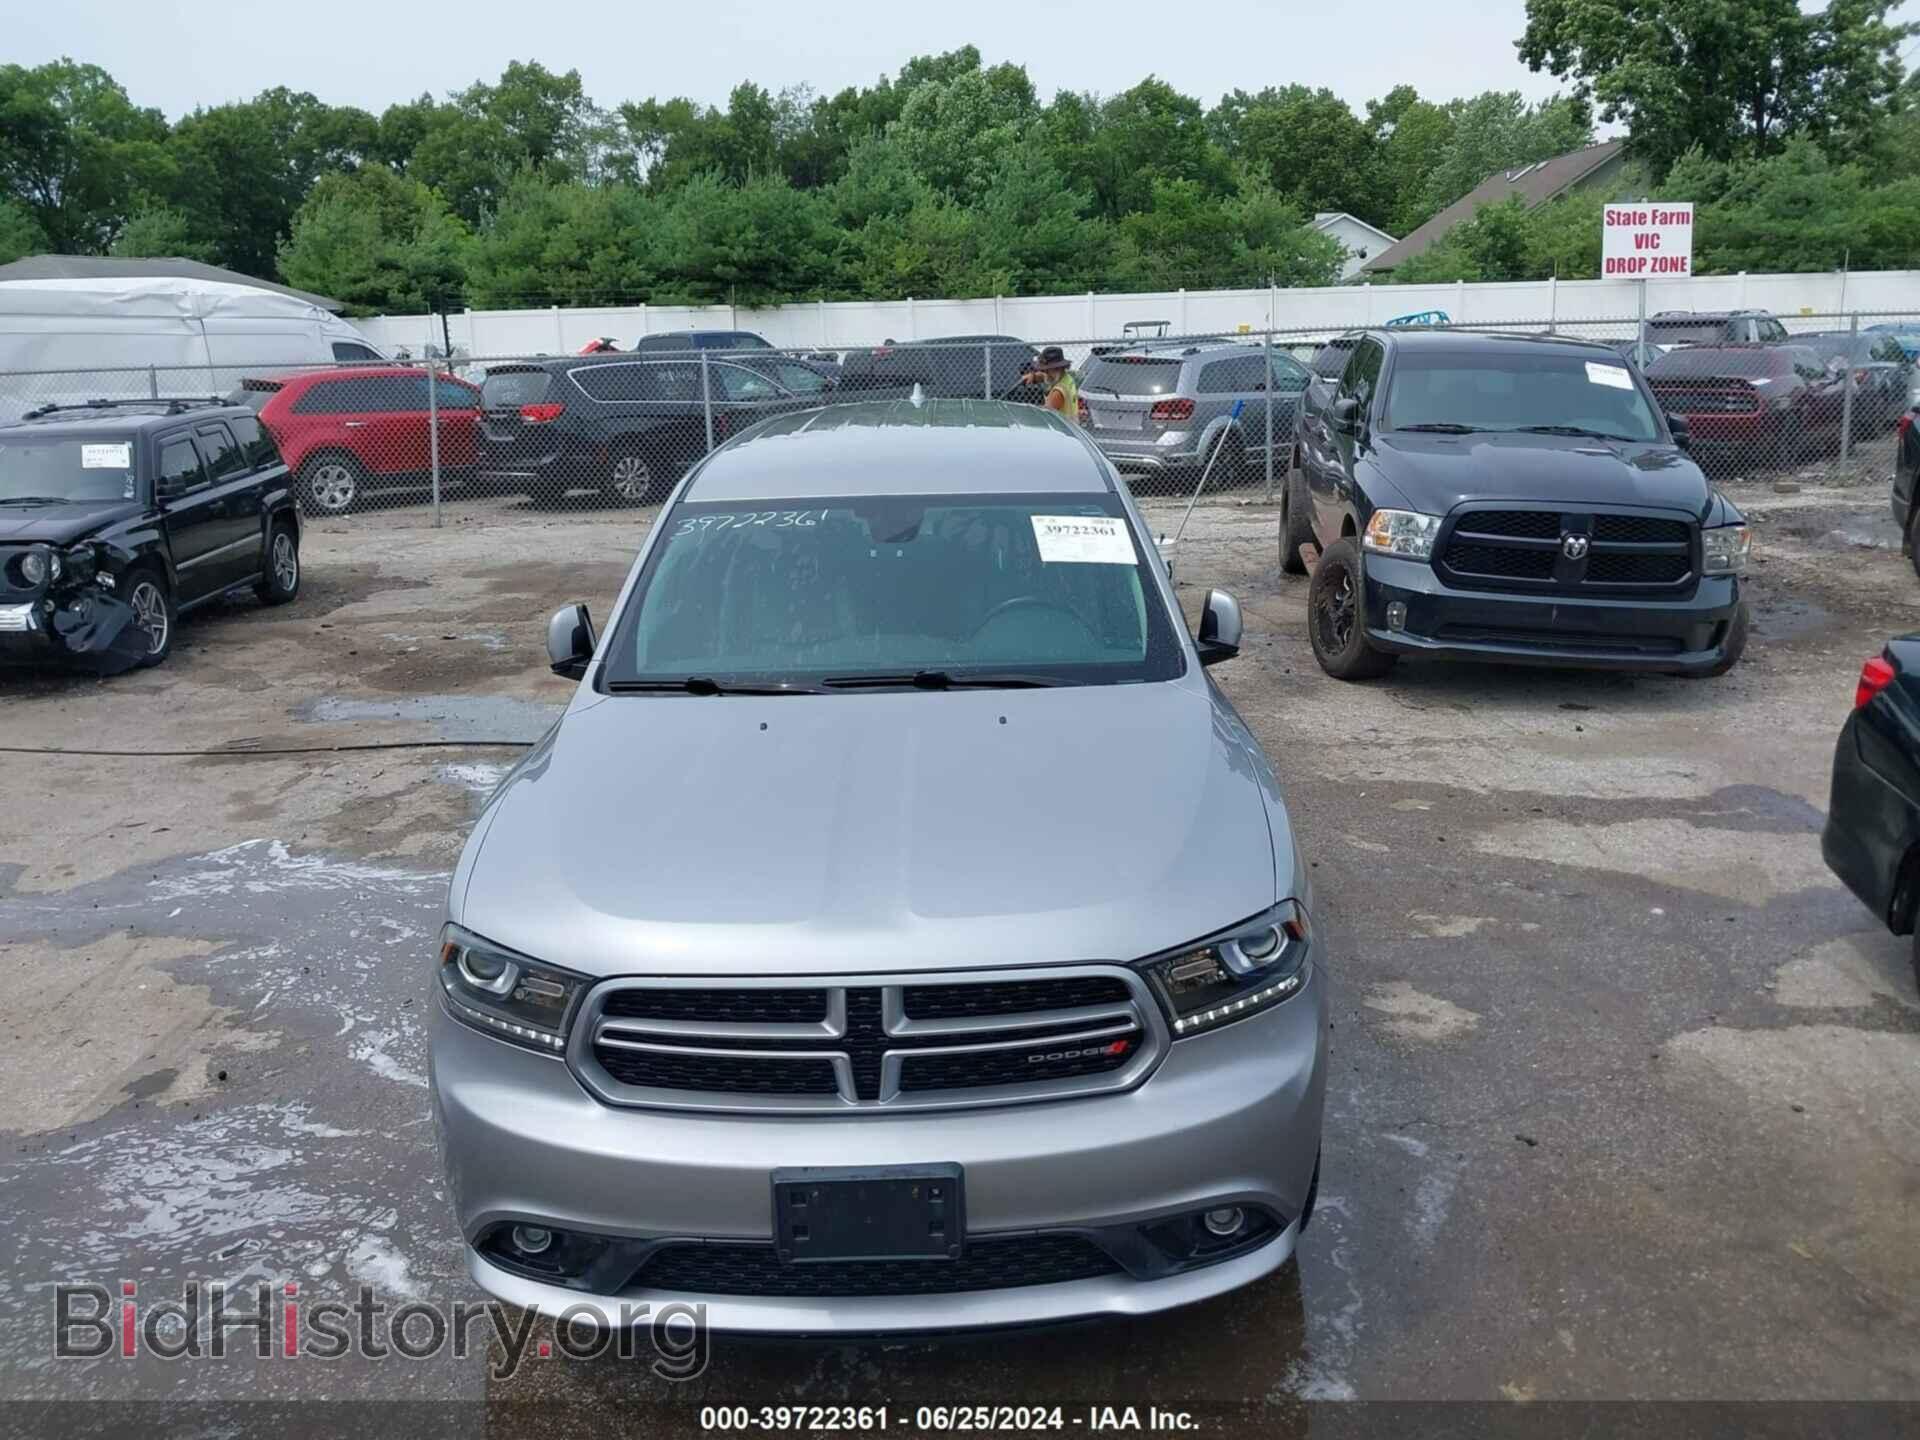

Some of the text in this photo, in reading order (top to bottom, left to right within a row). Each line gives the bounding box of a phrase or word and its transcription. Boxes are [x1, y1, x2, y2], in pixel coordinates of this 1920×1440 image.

[1606, 209, 1690, 226] State Farm
[1634, 233, 1660, 249] VIC
[1605, 256, 1687, 273] DROP ZONE
[1044, 524, 1117, 536] 39722361
